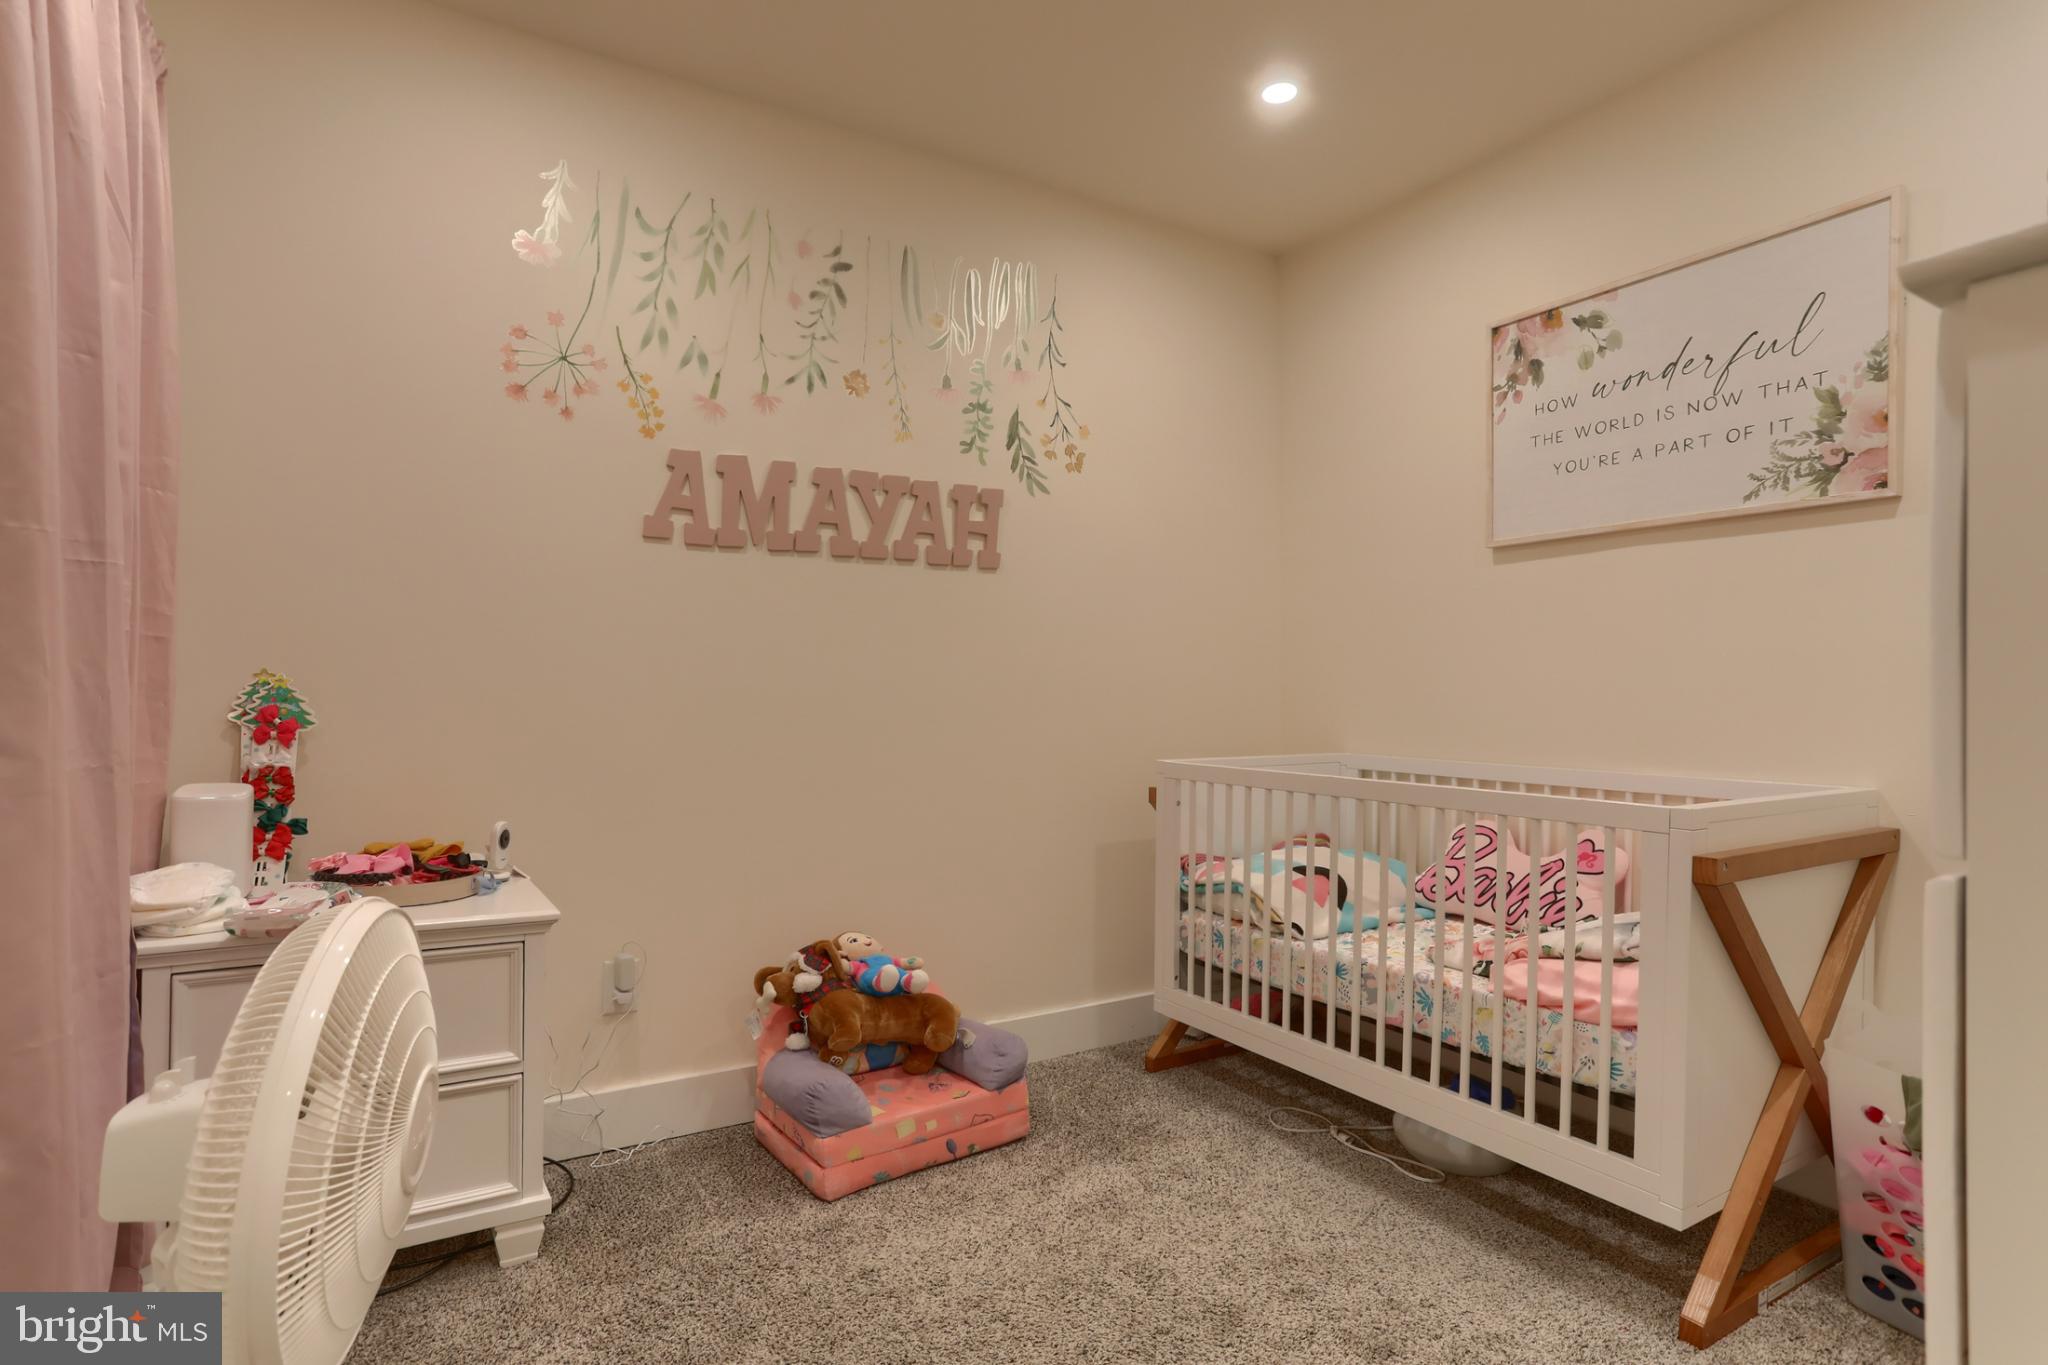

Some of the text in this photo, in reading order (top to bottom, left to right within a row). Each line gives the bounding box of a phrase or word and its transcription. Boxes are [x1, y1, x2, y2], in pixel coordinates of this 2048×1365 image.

[1534, 290, 1827, 416] HOW wonderful
[1531, 369, 1830, 449] THE WORLD IS NOW THAT
[1553, 416, 1796, 477] YOU'RE A PART OF IT
[643, 448, 1003, 571] AMAYAH
